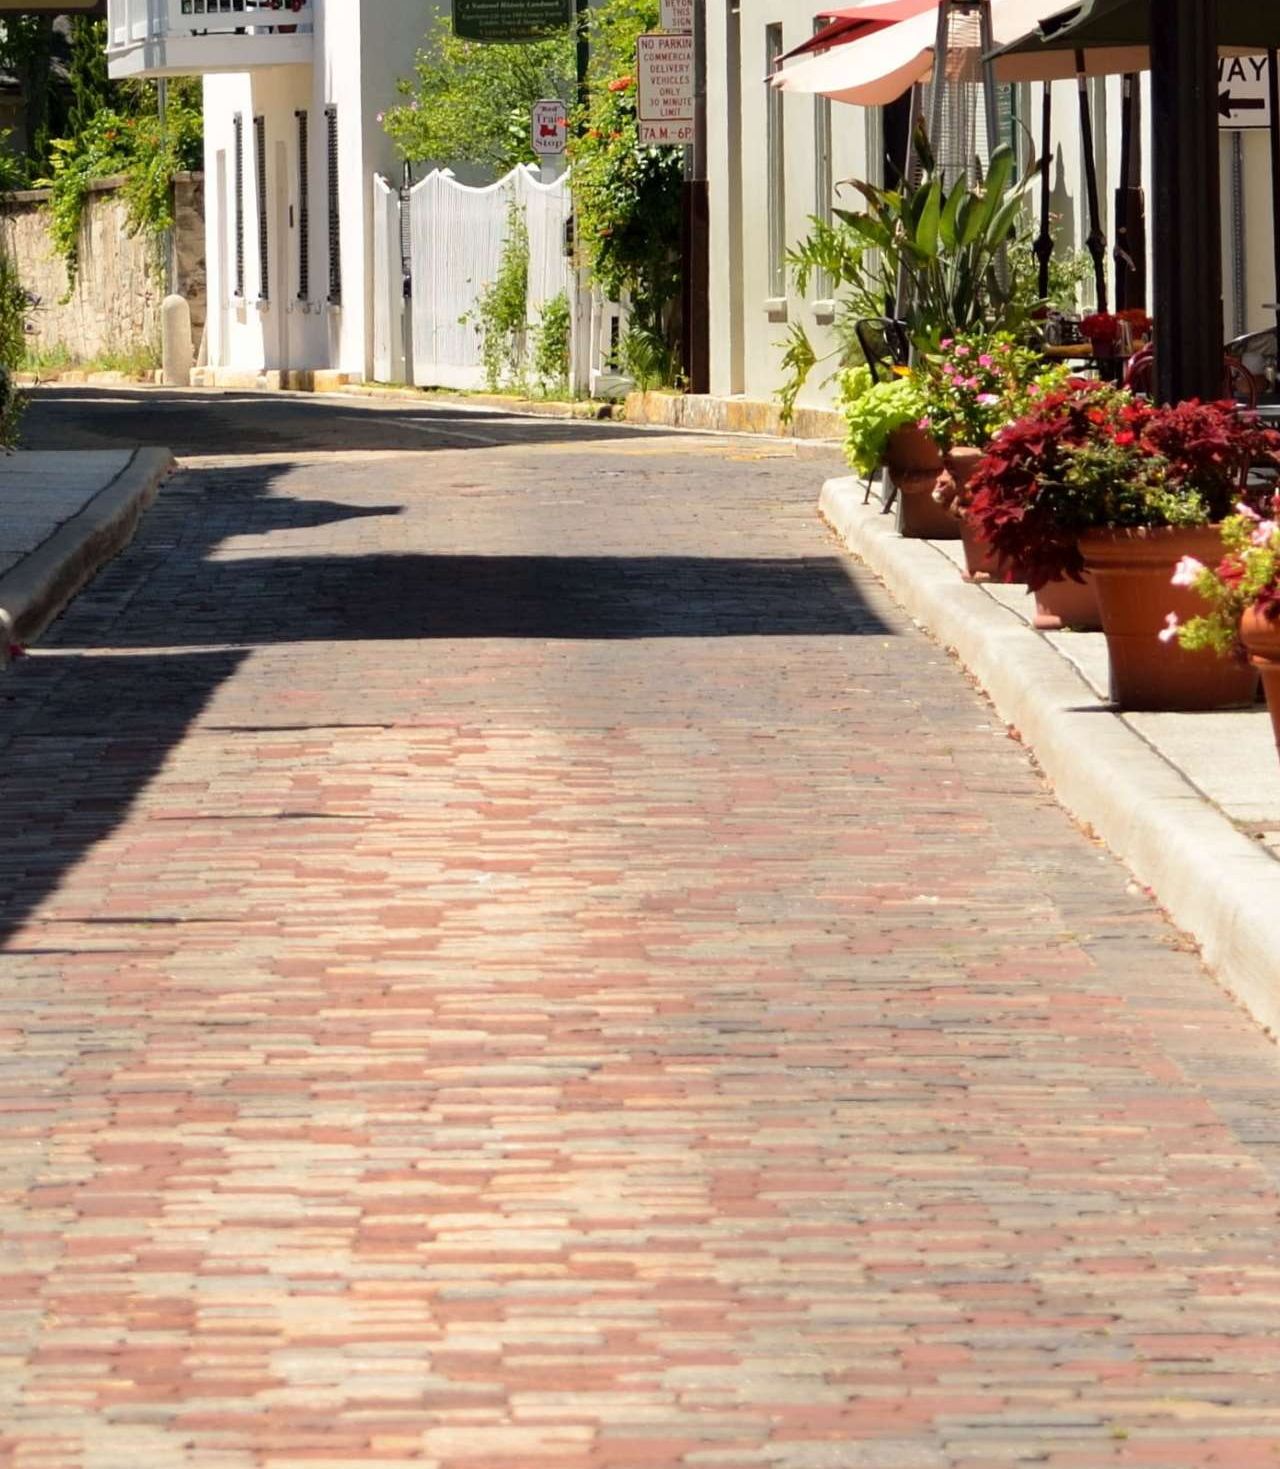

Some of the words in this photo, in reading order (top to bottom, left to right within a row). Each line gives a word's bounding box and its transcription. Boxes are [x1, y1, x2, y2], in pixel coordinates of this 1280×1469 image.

[672, 8, 690, 17] THIS
[672, 18, 691, 27] SIGN
[641, 39, 655, 49] NO
[650, 64, 689, 73] DELIVERY
[1218, 57, 1269, 82] AY
[650, 76, 690, 85] VEHICLES
[659, 88, 680, 96] ONLY
[650, 98, 660, 106] 30
[660, 108, 681, 117] LIMIT
[535, 138, 564, 149] Stop
